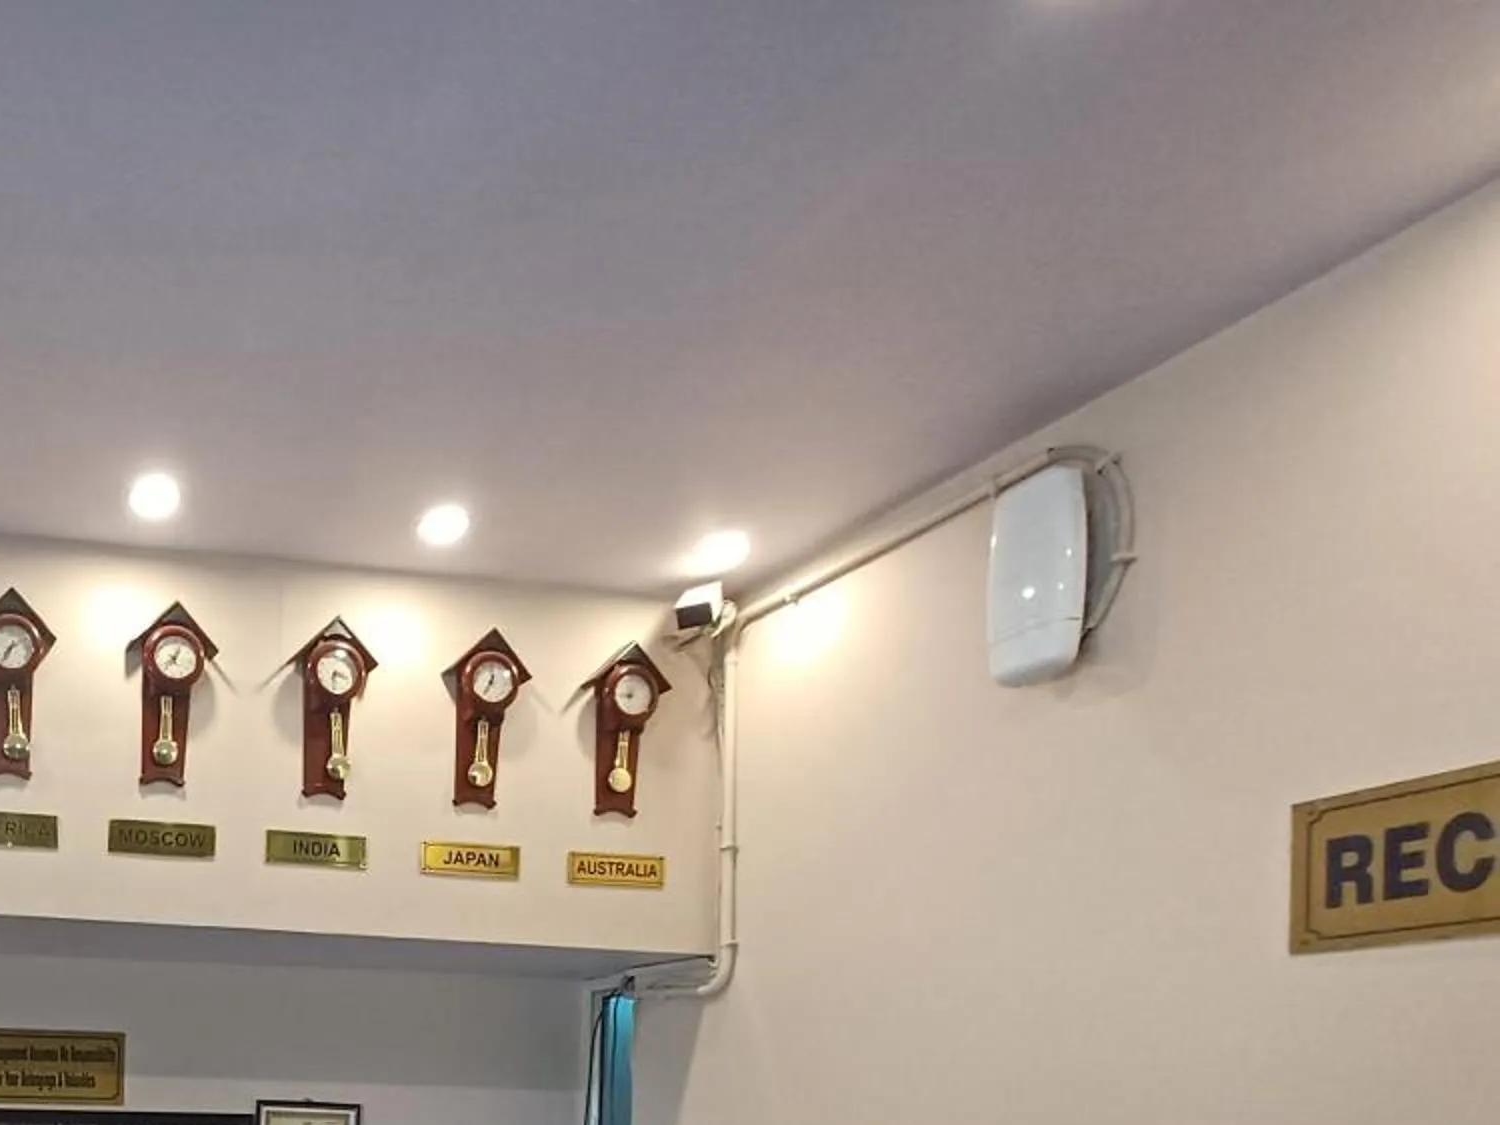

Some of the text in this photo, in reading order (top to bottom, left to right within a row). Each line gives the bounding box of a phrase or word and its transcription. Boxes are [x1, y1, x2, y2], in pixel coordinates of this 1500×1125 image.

[118, 828, 205, 849] MOSCOW
[293, 839, 341, 858] INDIA
[443, 851, 500, 868] JAPAN
[1325, 811, 1496, 910] REC
[576, 860, 658, 880] AUSTRALIA
